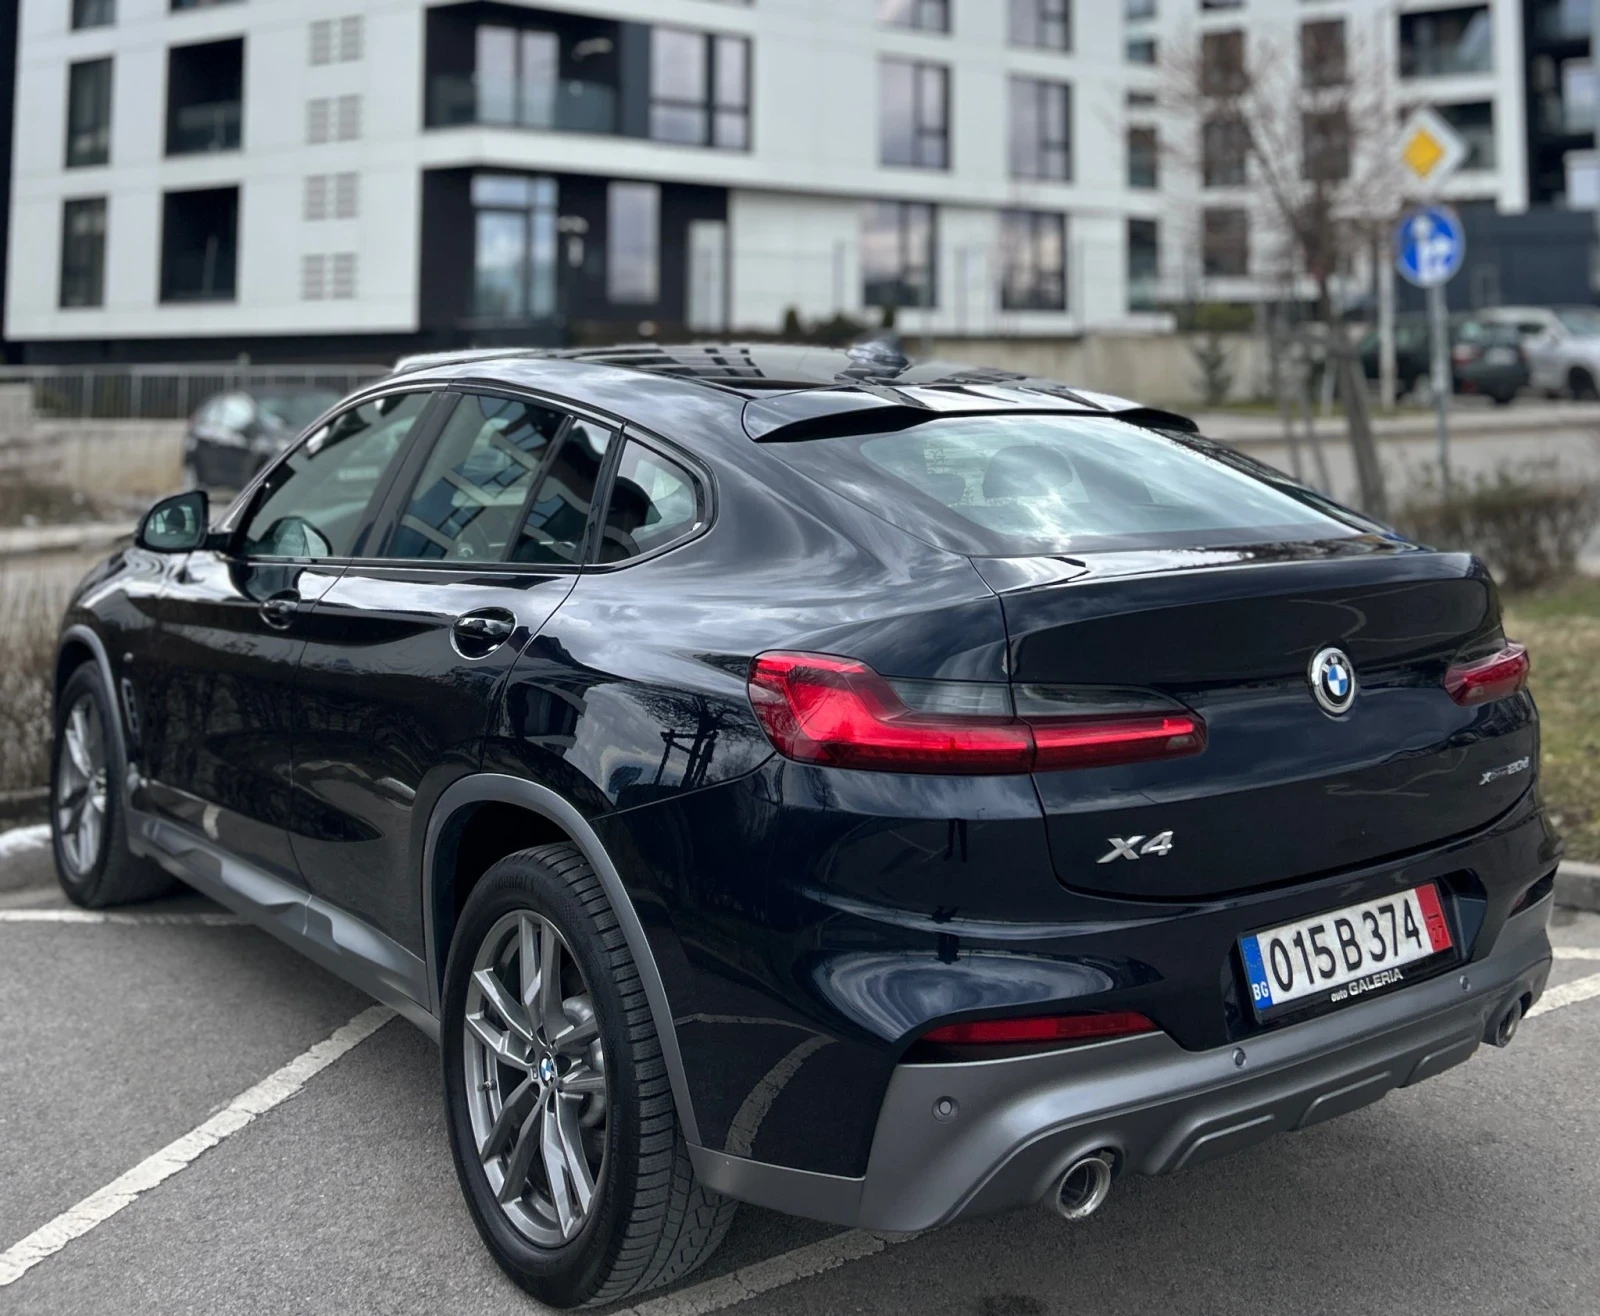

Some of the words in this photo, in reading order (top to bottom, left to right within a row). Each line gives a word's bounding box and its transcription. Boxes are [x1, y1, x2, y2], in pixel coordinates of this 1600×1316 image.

[1096, 830, 1174, 864] X4
[1268, 898, 1423, 993] 015B374
[1251, 980, 1270, 1001] BG
[1348, 967, 1404, 996] GALERIA
